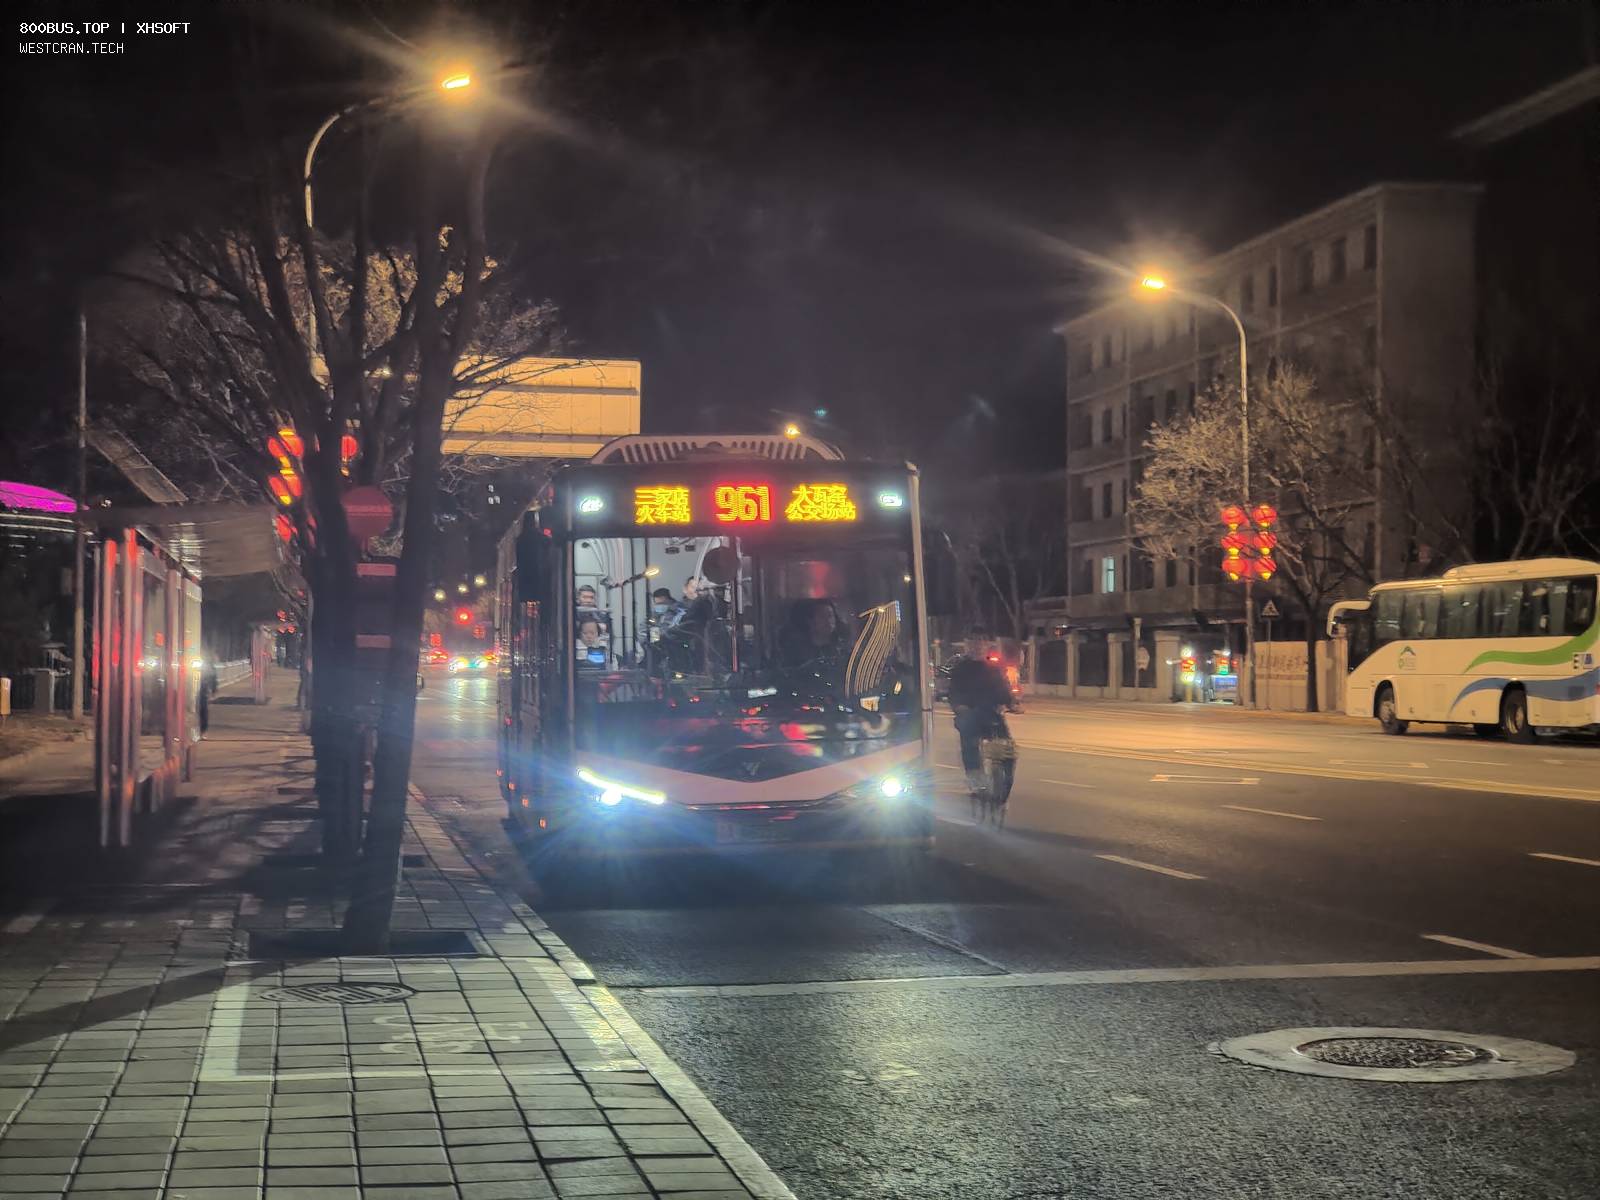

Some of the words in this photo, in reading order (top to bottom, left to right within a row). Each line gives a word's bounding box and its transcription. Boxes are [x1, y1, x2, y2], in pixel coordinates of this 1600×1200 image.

[634, 486, 690, 505] 三家店
[715, 485, 771, 522] 961
[634, 504, 691, 524] 火车站
[784, 502, 857, 521] 公交场站
